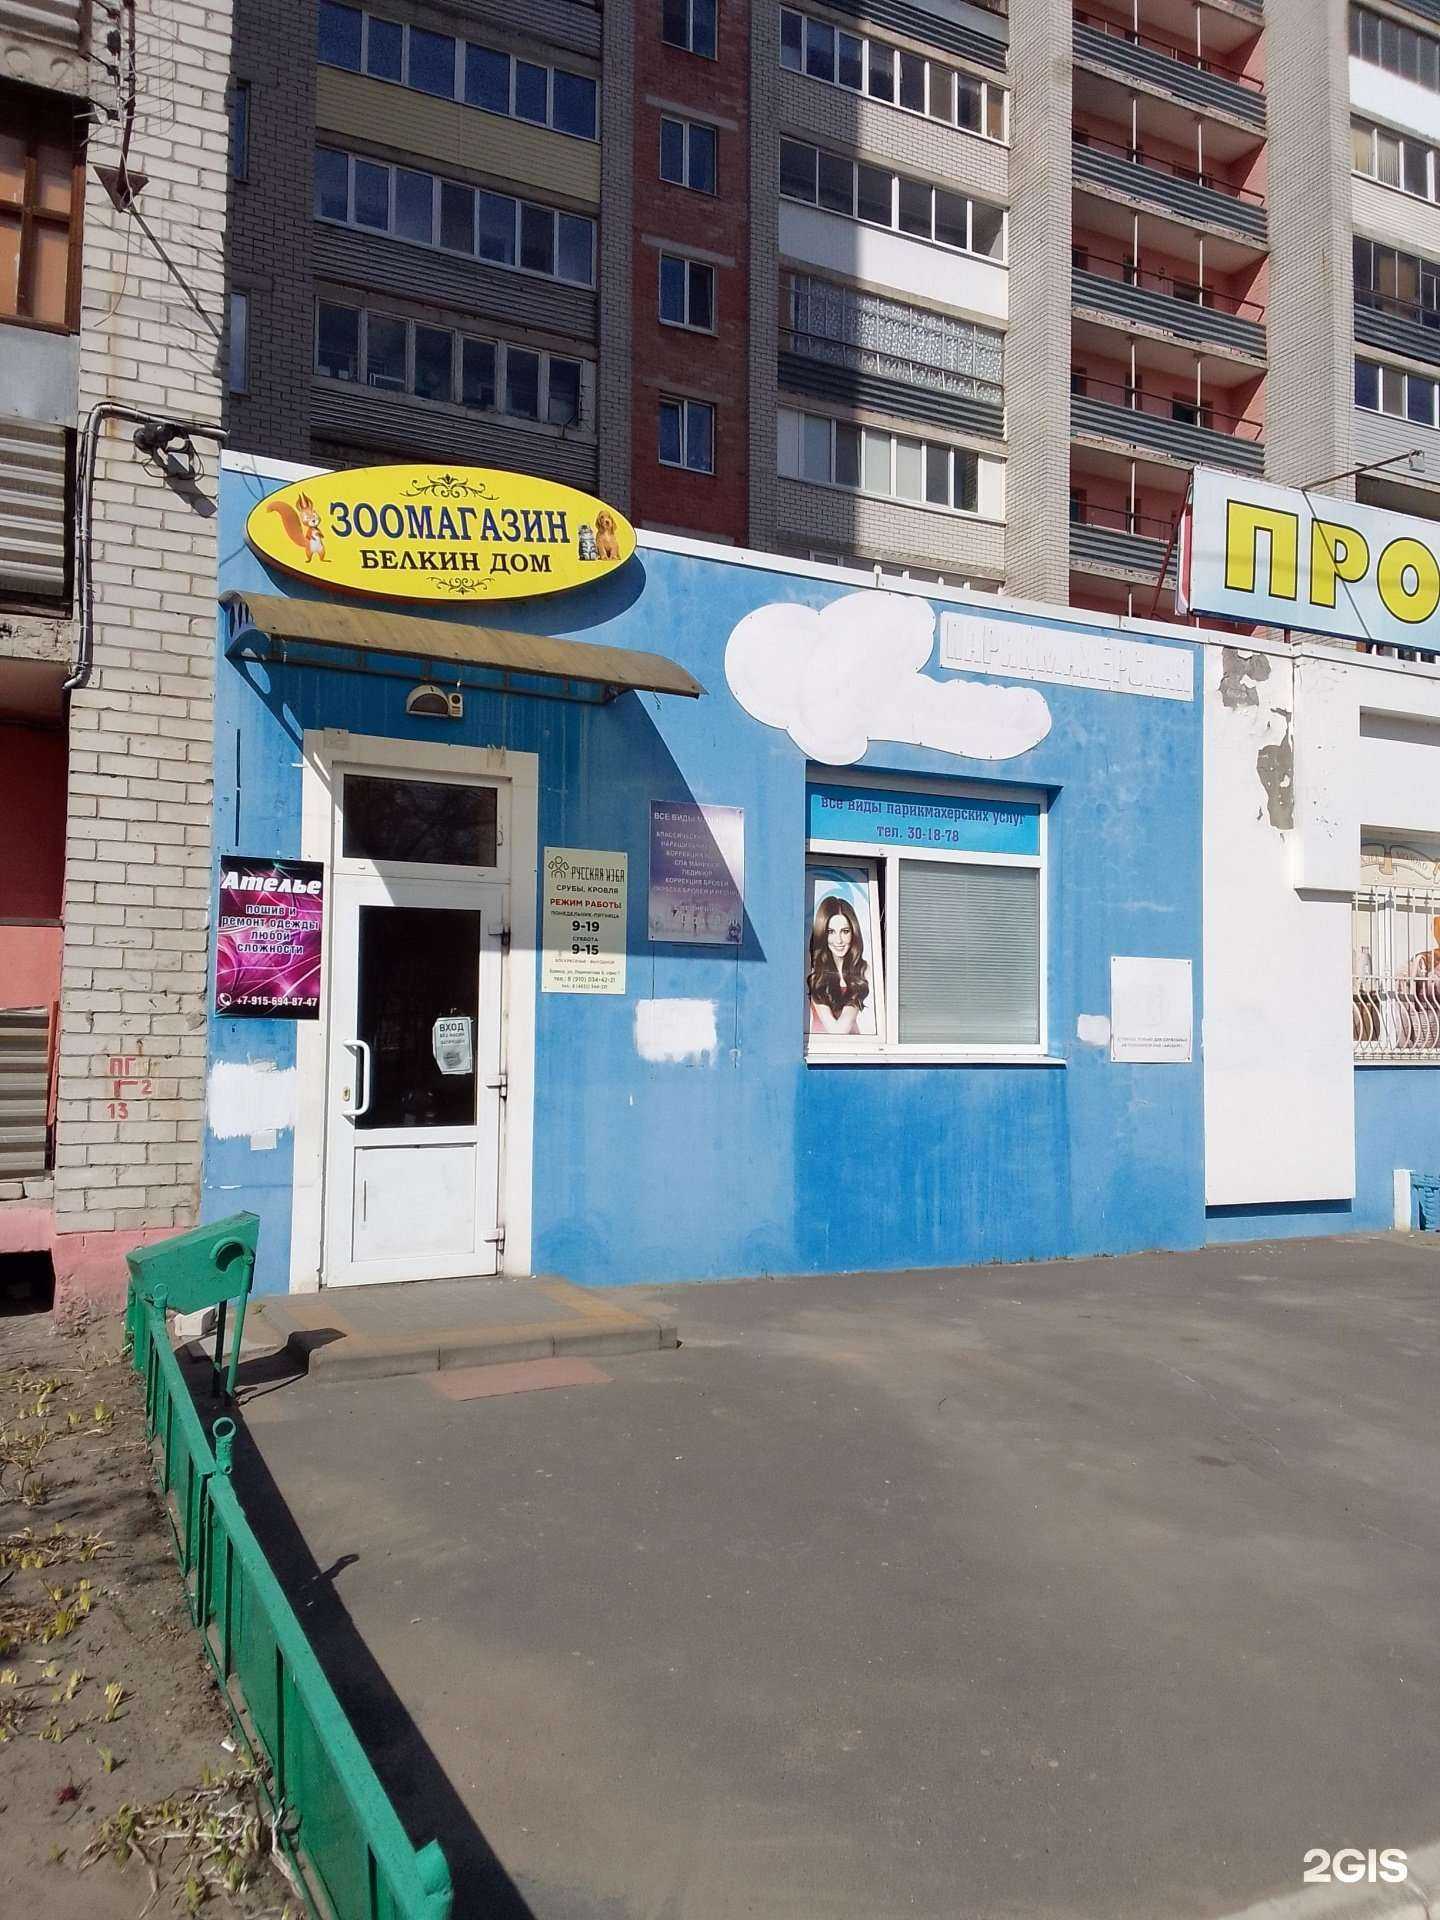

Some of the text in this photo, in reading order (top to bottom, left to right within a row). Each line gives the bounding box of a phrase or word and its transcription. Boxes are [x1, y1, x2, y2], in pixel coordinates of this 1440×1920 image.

[329, 501, 571, 544] ЗООМАГАЗИН
[360, 549, 552, 574] БЕЛКИН ДОМ
[1224, 498, 1440, 625] ПРО
[821, 797, 1025, 826] все виды парикмахерских услуг
[877, 825, 960, 842] тел. 30-18-78
[571, 866, 625, 882] РУССКАЯ ИЗБА
[221, 871, 322, 895] Ателье
[588, 886, 619, 894] КРОВЛЯ
[246, 904, 296, 915] пошив и
[550, 898, 622, 909] РЕЖИМ РАБОТЫ
[221, 916, 319, 931] ремонт одежды
[572, 920, 600, 932] 9-19
[251, 930, 291, 941] любой
[237, 943, 304, 954] сложности
[571, 944, 599, 955] 9-15
[236, 996, 318, 1007] +7-915-694-87-47
[439, 1022, 465, 1032] ВХОД
[109, 1056, 136, 1075] ПГ
[107, 1102, 128, 1119] 13
